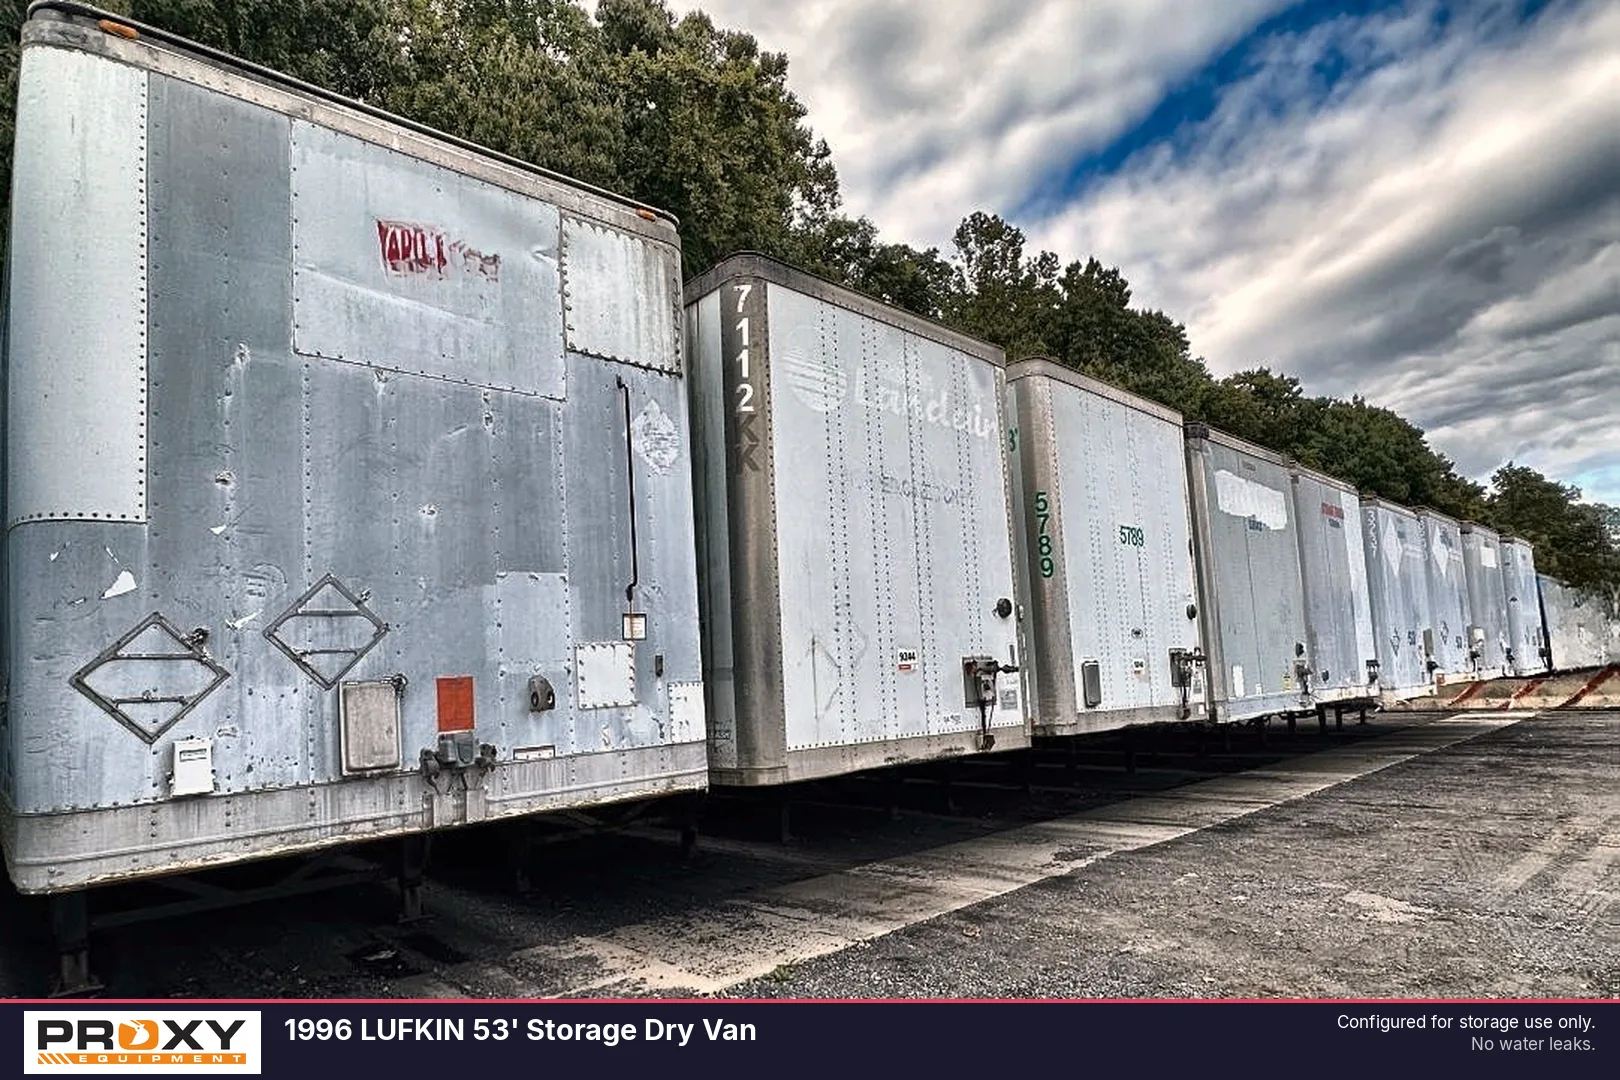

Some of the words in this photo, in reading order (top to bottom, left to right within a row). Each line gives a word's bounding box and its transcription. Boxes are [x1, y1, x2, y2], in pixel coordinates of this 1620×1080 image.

[733, 284, 755, 412] 7112
[1035, 491, 1054, 578] 5789
[1119, 525, 1144, 547] 5789
